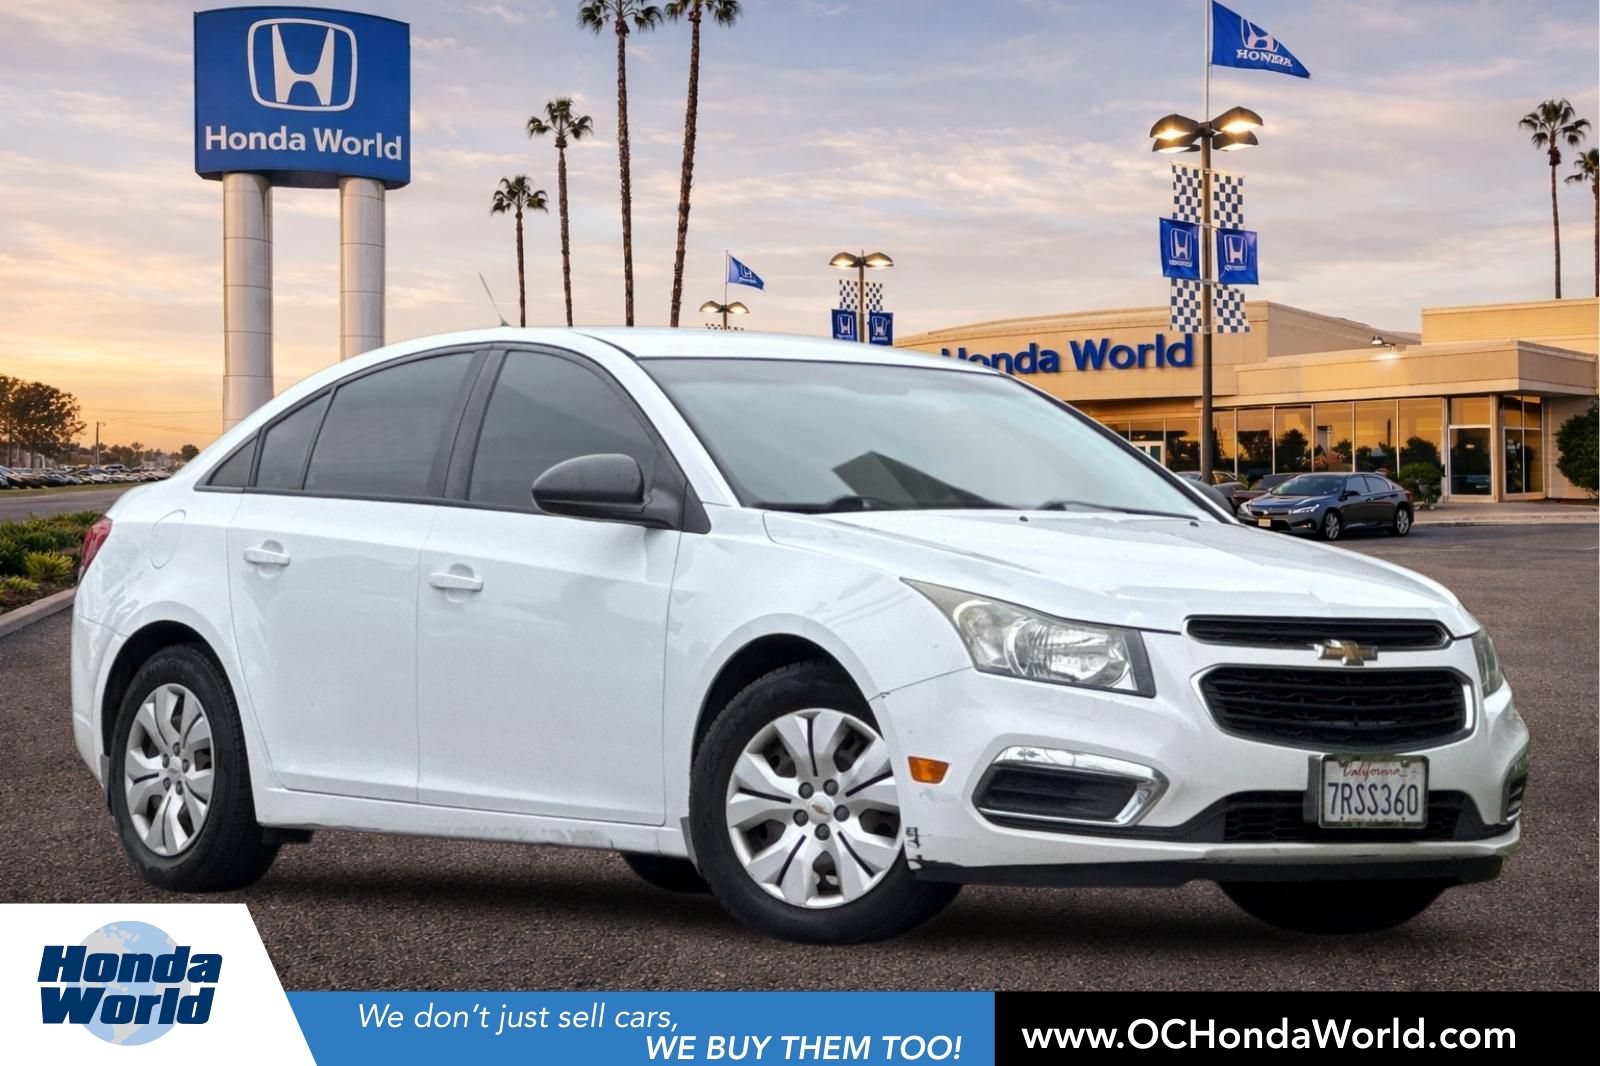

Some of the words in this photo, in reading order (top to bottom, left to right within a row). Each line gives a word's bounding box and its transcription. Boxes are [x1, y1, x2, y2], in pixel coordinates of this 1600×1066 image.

[205, 125, 306, 151] Honda
[313, 127, 402, 160] World
[1069, 333, 1194, 371] World
[1343, 760, 1400, 781] California
[1328, 782, 1418, 816] 7RSS360
